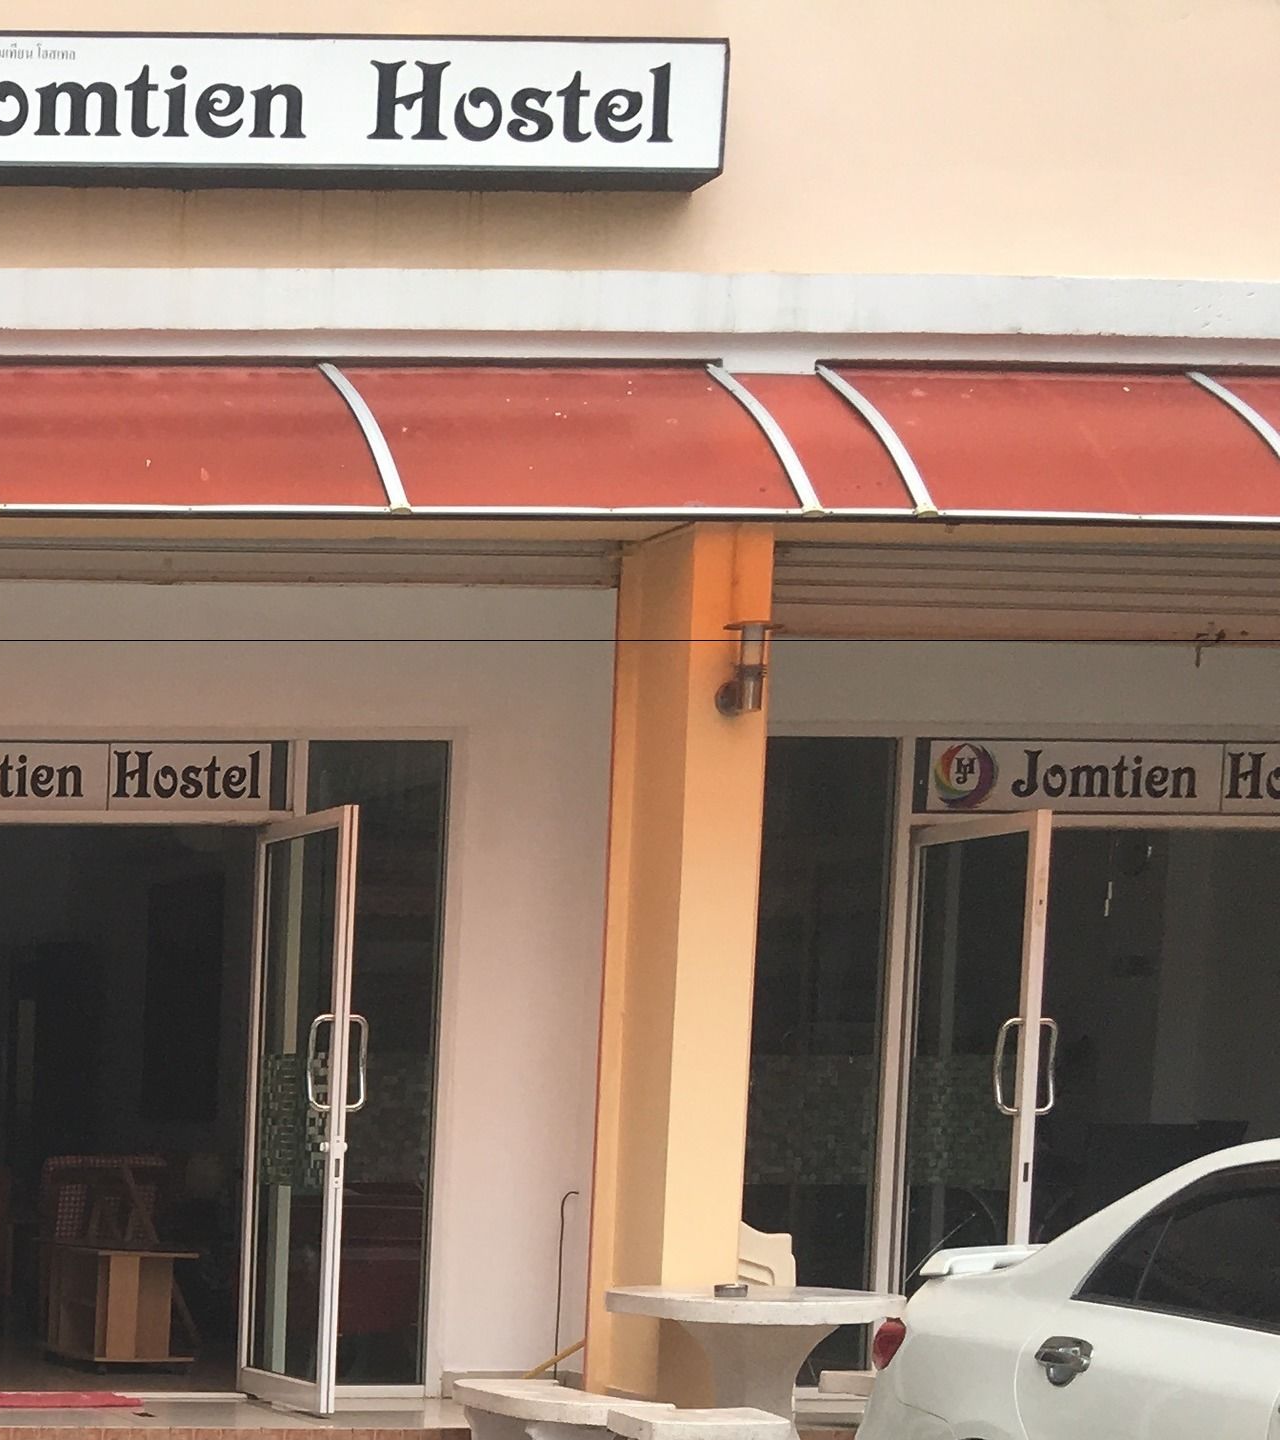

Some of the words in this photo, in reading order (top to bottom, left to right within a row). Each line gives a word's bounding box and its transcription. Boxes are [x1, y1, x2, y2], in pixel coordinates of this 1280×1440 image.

[366, 59, 673, 144] Hostel
[112, 750, 261, 799] Hostel
[1011, 750, 1197, 799] Jomtien
